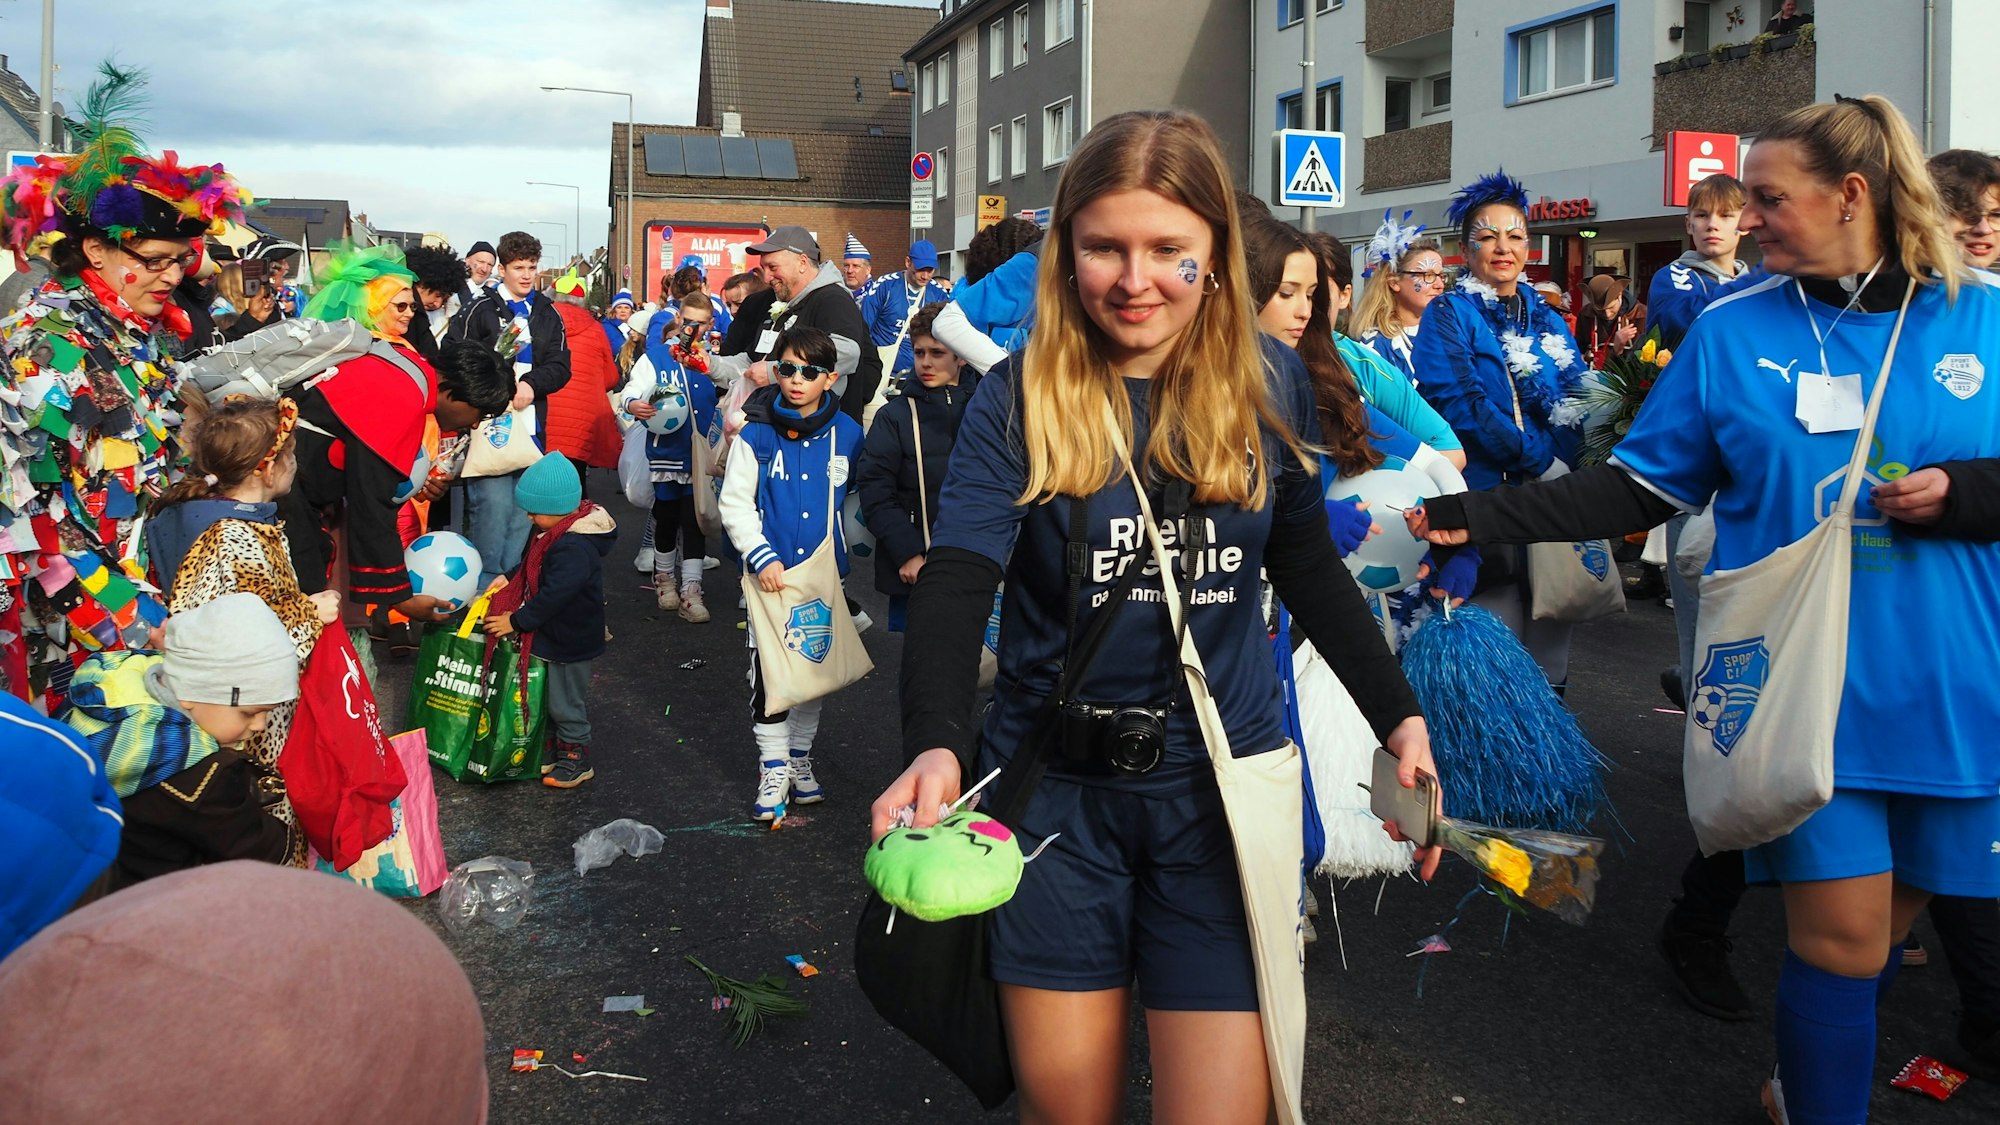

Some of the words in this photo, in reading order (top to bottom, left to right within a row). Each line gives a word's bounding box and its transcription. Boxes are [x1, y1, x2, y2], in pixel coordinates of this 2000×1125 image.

[691, 238, 727, 251] ALAAF
[1860, 532, 1892, 547] Haus
[1093, 546, 1243, 583] Energie
[799, 607, 817, 617] SPORT
[800, 614, 818, 623] CLUB
[810, 643, 825, 654] 1912
[437, 654, 472, 676] Mein
[1723, 651, 1756, 668] SPORT
